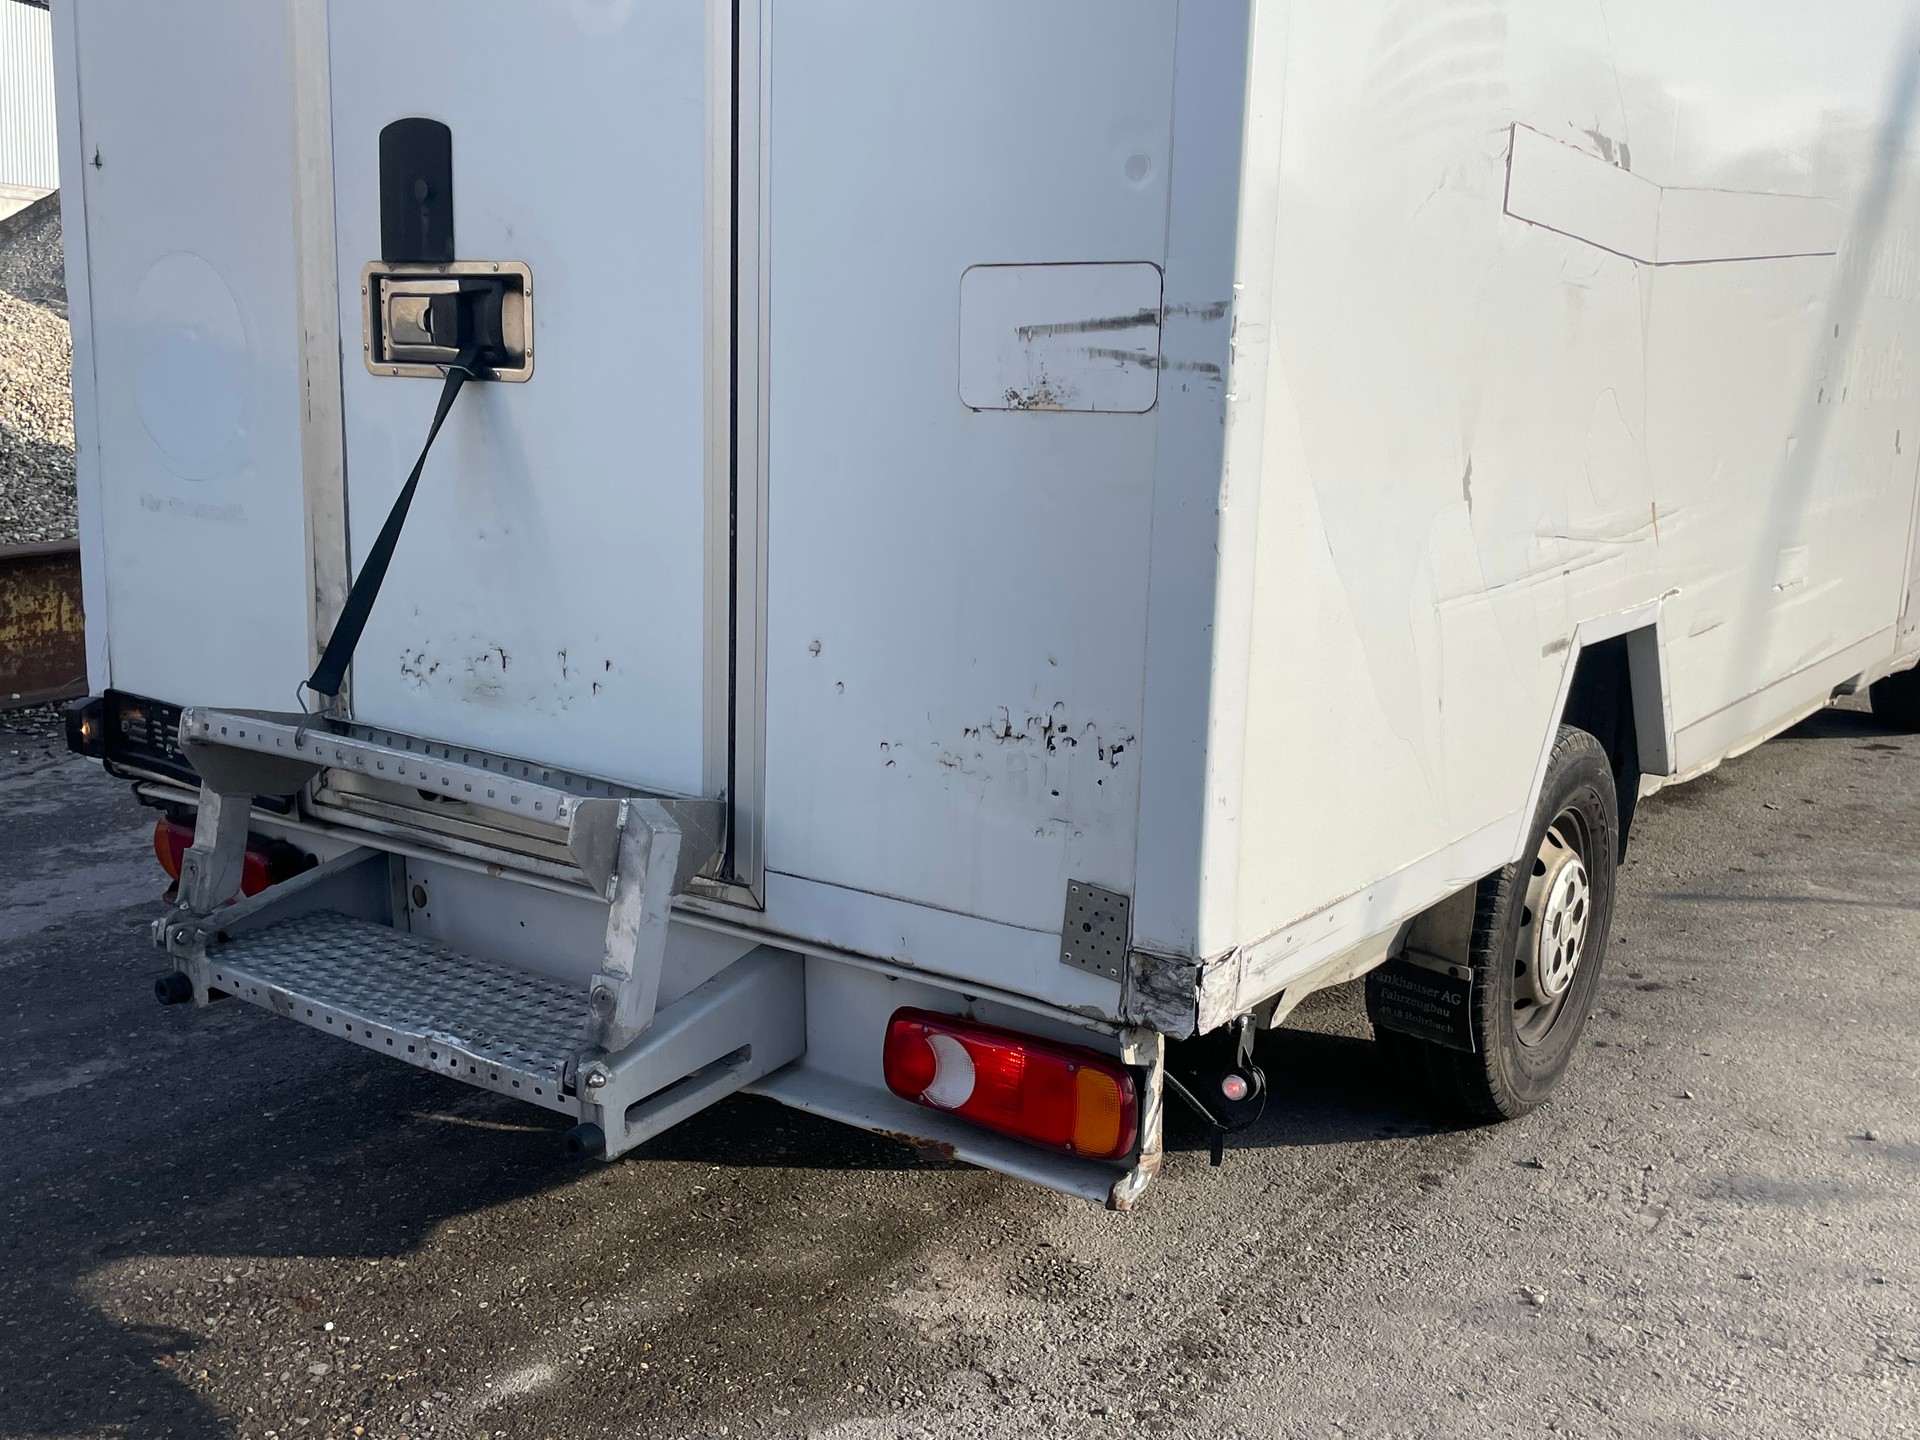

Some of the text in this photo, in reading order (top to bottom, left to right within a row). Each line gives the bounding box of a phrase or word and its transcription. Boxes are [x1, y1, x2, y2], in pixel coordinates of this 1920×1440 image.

[1381, 988, 1450, 1017] Fahrzeugbau
[1440, 990, 1462, 1005] AG
[1405, 1011, 1454, 1033] Rohrbach
